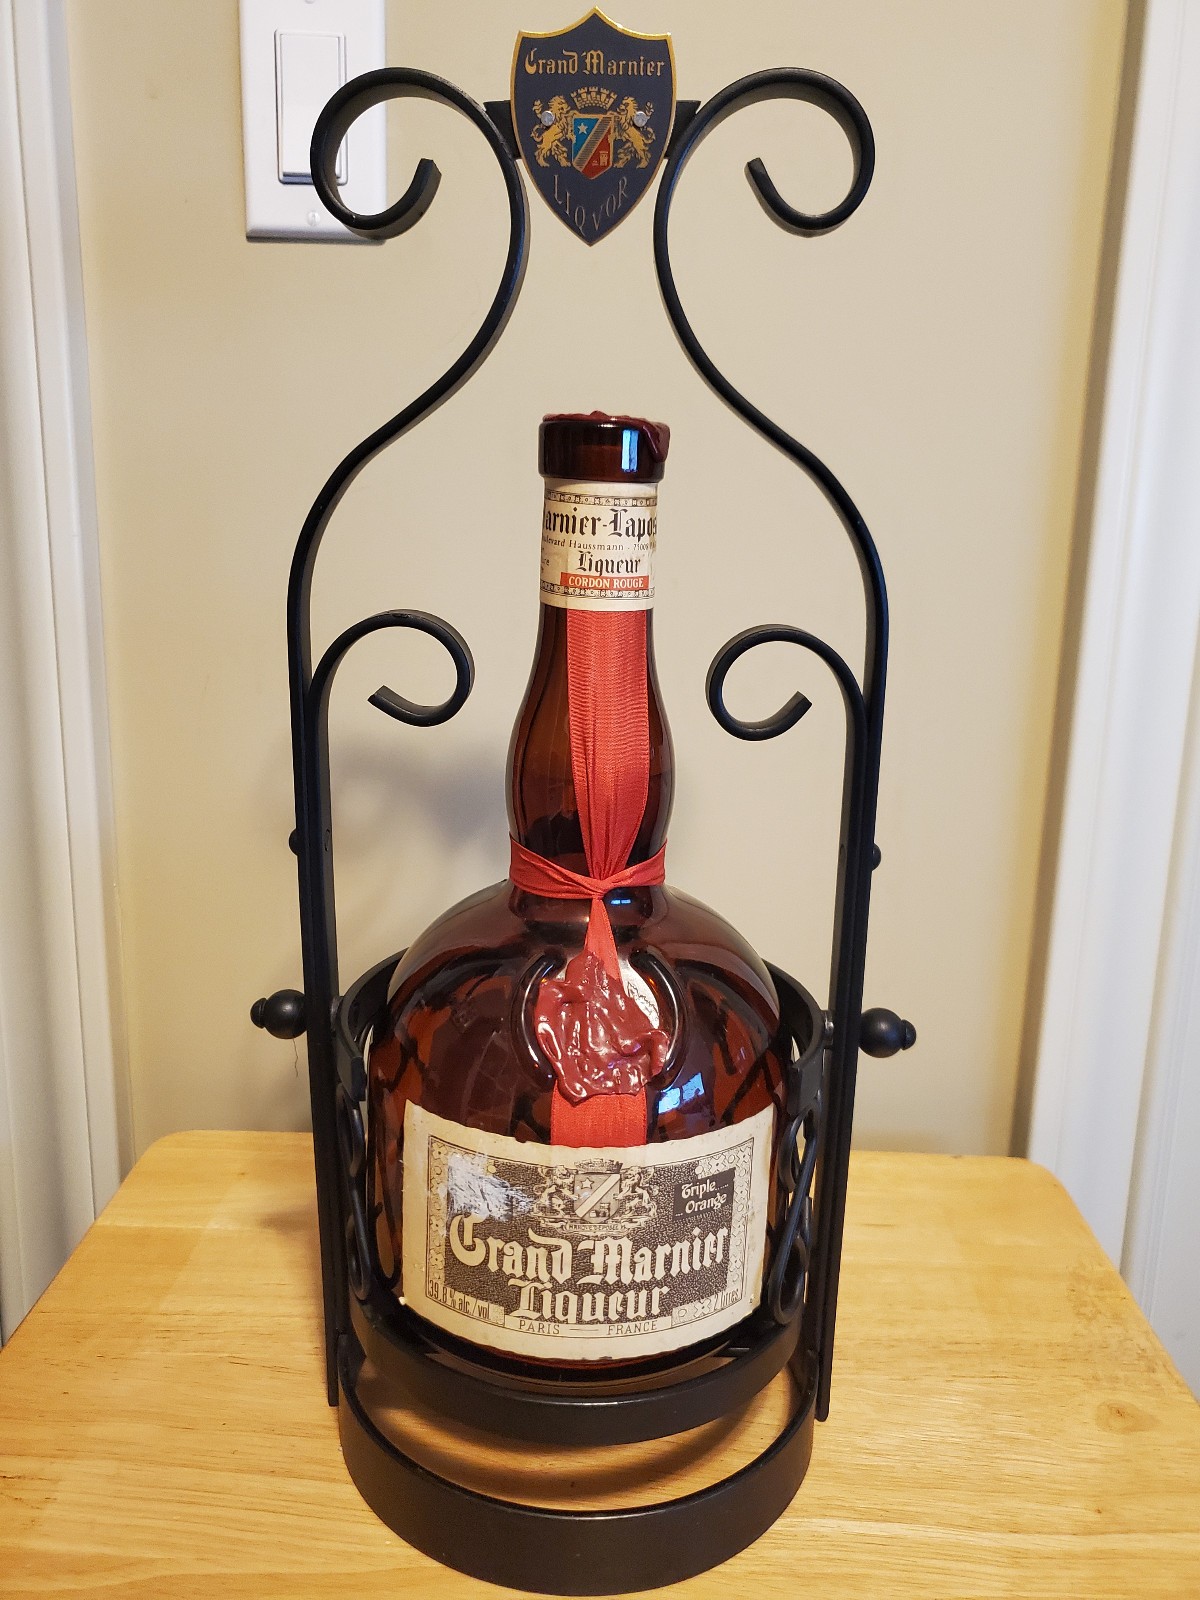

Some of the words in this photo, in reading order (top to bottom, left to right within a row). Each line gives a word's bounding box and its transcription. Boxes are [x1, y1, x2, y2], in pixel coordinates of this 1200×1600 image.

[524, 48, 578, 75] Grand
[581, 50, 665, 77] Marnier
[569, 539, 624, 551] Haussmann
[575, 550, 641, 576] Liqueur
[568, 576, 611, 588] CORDON
[612, 577, 645, 589] ROUGE
[685, 1192, 728, 1212] Orange
[450, 1213, 572, 1285] Grand
[578, 1226, 730, 1286] Marnier
[508, 1277, 670, 1324] Liqueur
[518, 1319, 561, 1336] PARIS
[606, 1319, 659, 1336] FRANCE
